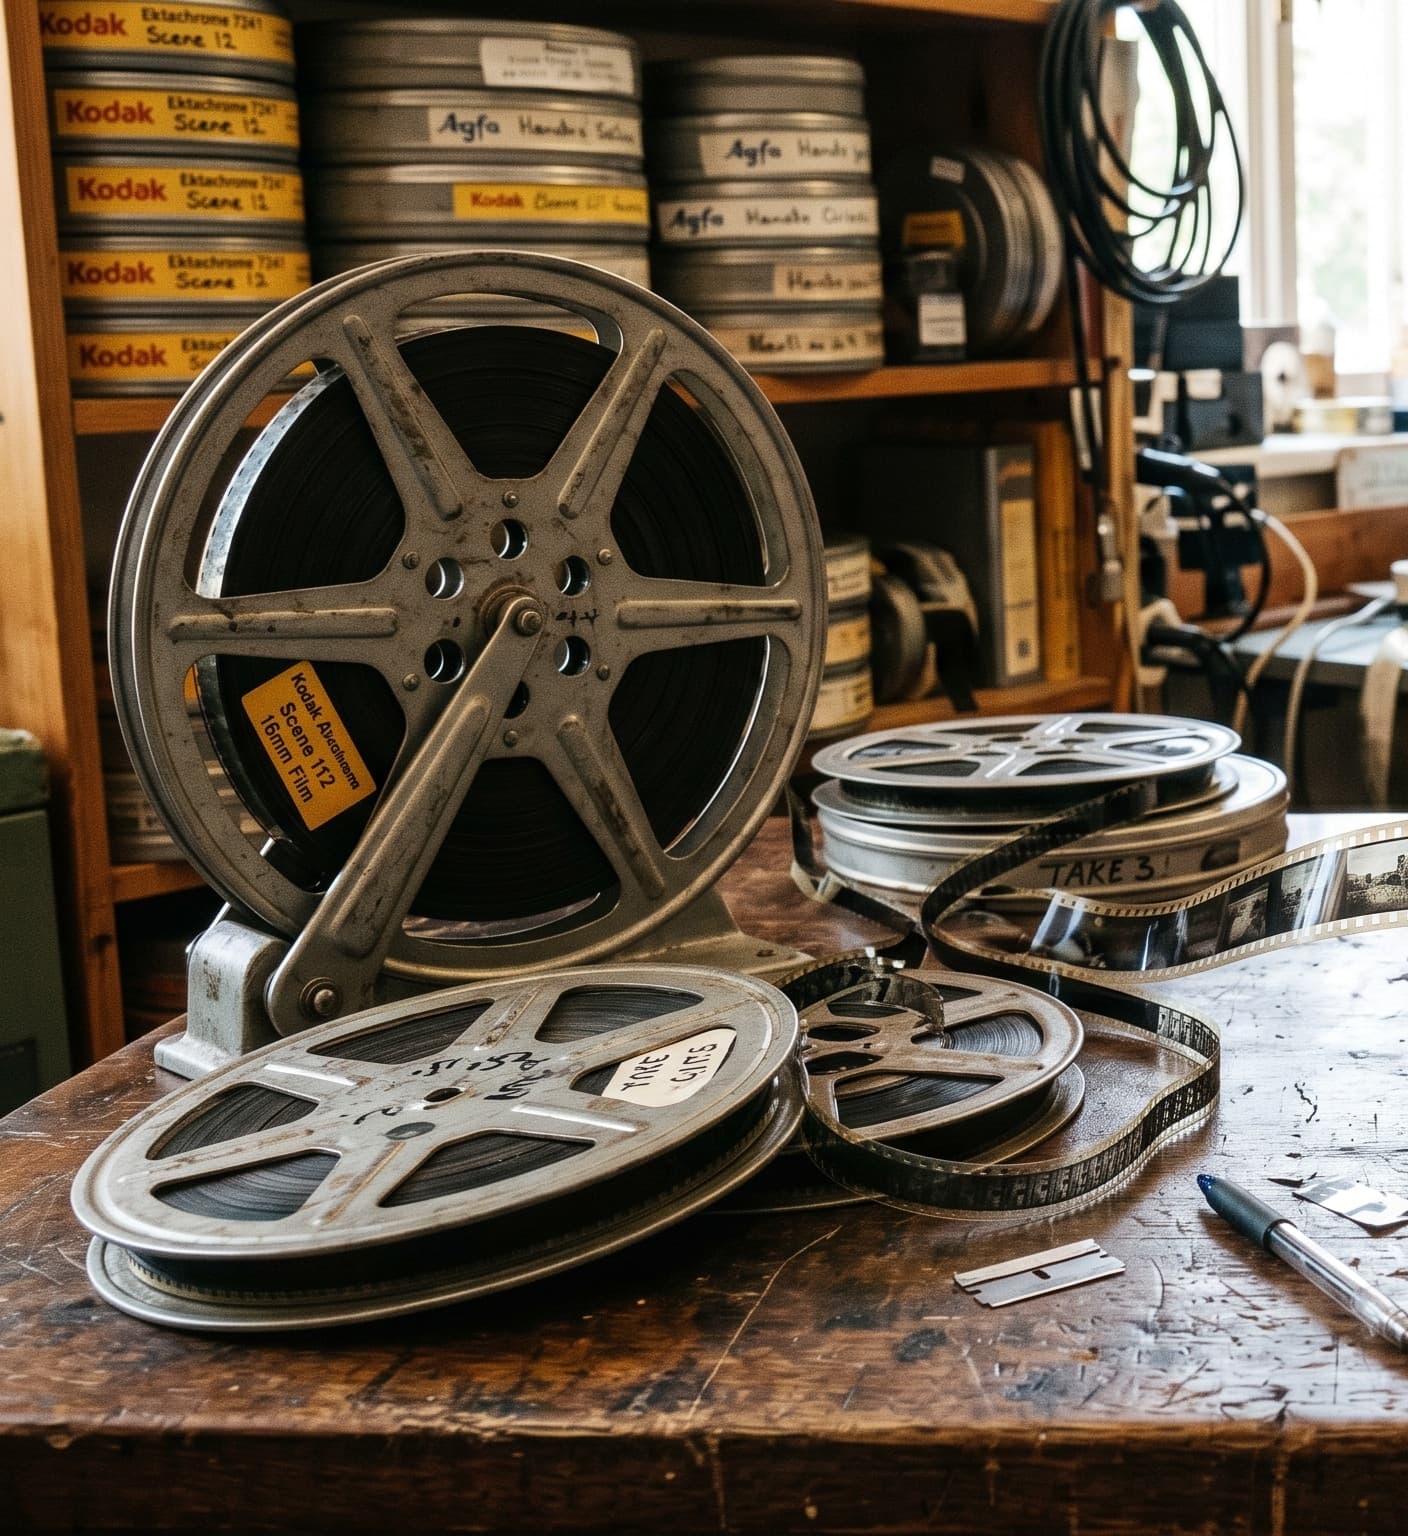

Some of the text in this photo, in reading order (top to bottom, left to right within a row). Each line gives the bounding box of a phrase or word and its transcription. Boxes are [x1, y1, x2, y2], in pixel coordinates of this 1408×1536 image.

[40, 12, 127, 36] Kodak
[65, 100, 155, 125] Kodak
[438, 112, 500, 142] Agfa
[726, 138, 782, 167] Agfa
[77, 177, 167, 201] Kodak
[670, 207, 724, 235] Agfa
[67, 261, 155, 285] Kodak
[79, 343, 168, 368] Kodak
[291, 672, 323, 721] Kodak
[279, 701, 314, 757] Scene
[260, 714, 313, 803] 16mm Film
[1038, 859, 1123, 887] TAKE
